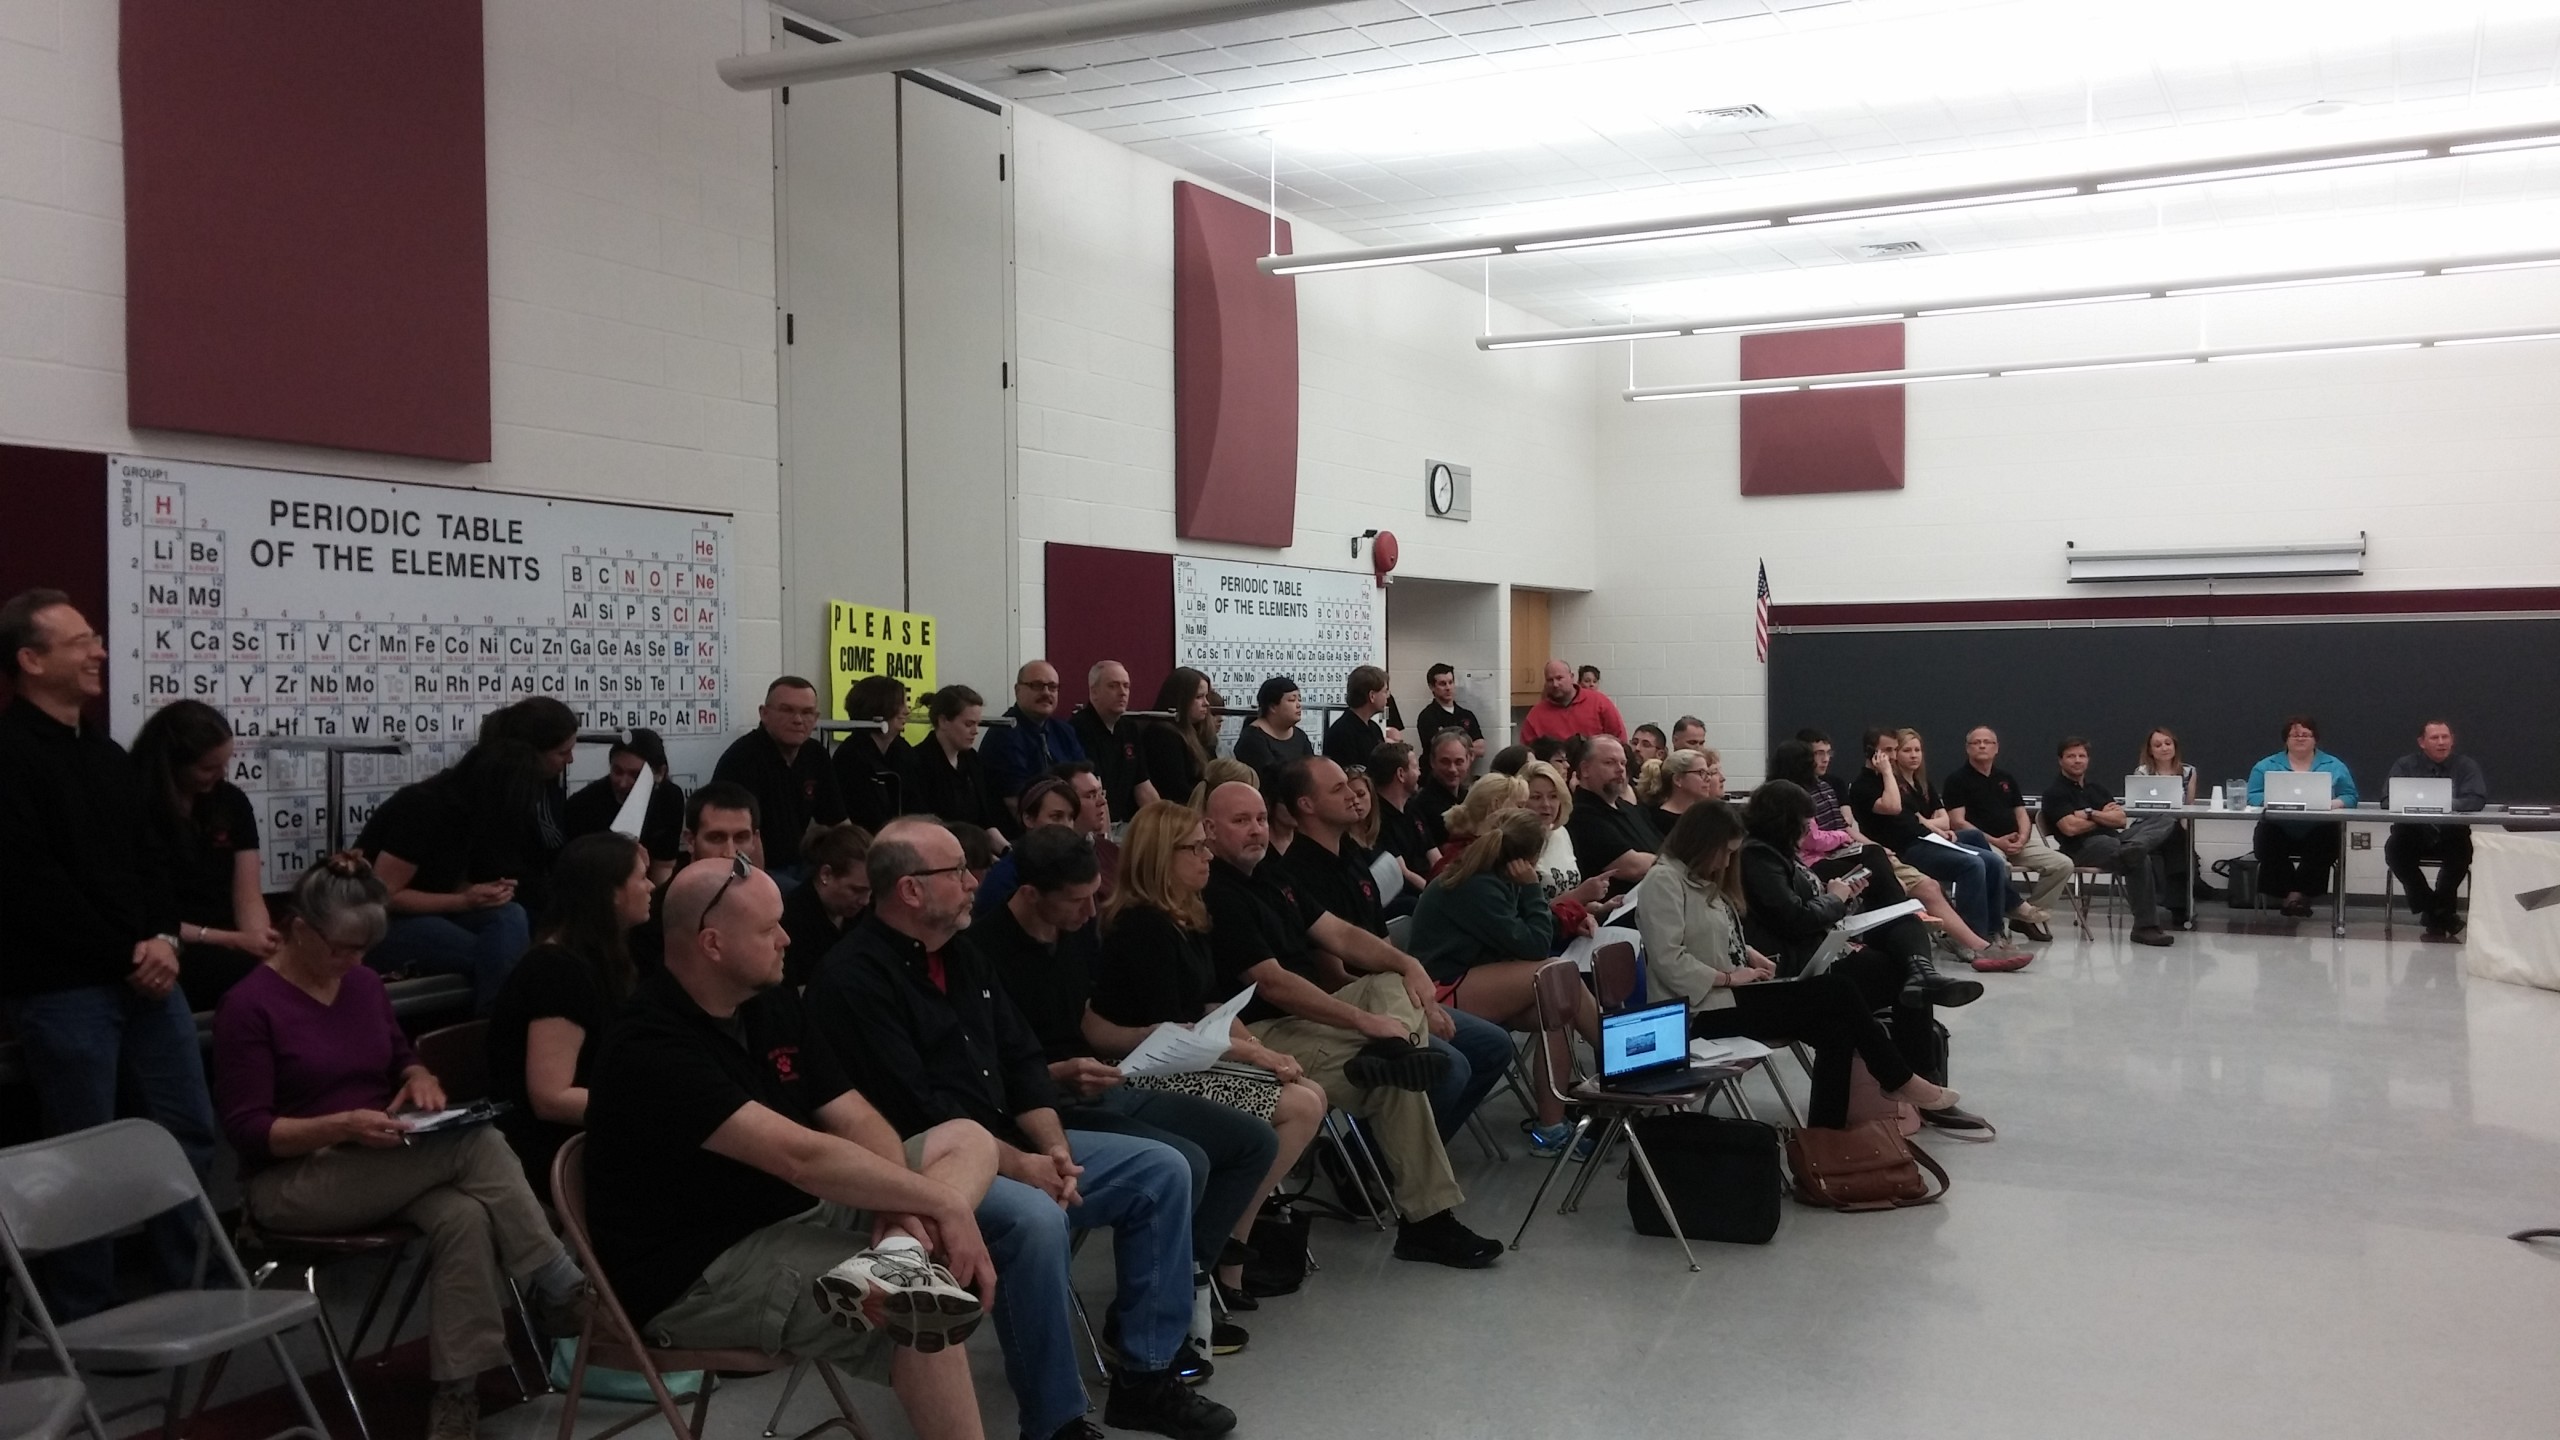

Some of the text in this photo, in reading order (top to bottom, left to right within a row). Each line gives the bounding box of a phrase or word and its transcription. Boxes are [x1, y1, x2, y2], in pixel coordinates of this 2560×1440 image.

[155, 495, 172, 515] H
[270, 499, 524, 545] PERIODIC TABLE
[154, 540, 174, 560] Li
[190, 541, 219, 563] Be
[695, 540, 714, 556] He
[131, 557, 139, 569] 2
[250, 538, 541, 582] OF THE ELEMENTS
[212, 576, 224, 588] 12
[571, 565, 583, 582] B
[598, 567, 610, 584] C
[624, 569, 635, 586] N
[649, 570, 661, 587] O
[676, 572, 685, 589] F
[695, 573, 715, 590] Ne
[1220, 575, 1303, 597] PERIODIC TABLE
[149, 584, 178, 606] Na
[188, 586, 221, 608] Mg
[131, 602, 140, 614] 3
[571, 602, 587, 619] Al
[598, 603, 614, 620] Si
[626, 604, 636, 621] P
[651, 605, 661, 622] S
[1196, 600, 1206, 611] Be
[1214, 597, 1309, 618] OF THE ELEMENTS
[1326, 608, 1332, 619] C
[673, 606, 689, 623] Cl
[697, 607, 714, 624] Ar
[1362, 610, 1370, 621] Ne
[210, 620, 224, 631] 20
[834, 604, 931, 646] PLEASE
[1185, 623, 1195, 635] Na
[1196, 624, 1207, 636] Mg
[156, 629, 171, 650] K
[190, 630, 220, 651] Ca
[232, 631, 260, 651] Sc
[276, 632, 296, 651] Ti
[316, 633, 330, 651] V
[347, 633, 371, 652] Cr
[380, 635, 407, 653] Mn
[415, 635, 436, 654] Fe
[1363, 631, 1370, 641] Ar
[444, 636, 470, 654] Co
[479, 636, 498, 654] Ni
[509, 637, 534, 655] Cu
[541, 637, 563, 655] Zn
[570, 638, 591, 656] Ga
[597, 639, 618, 656] Ge
[623, 639, 642, 656] As
[648, 640, 666, 657] Se
[674, 641, 690, 657] Br
[698, 641, 715, 657] Kr
[1187, 647, 1193, 659] K
[132, 648, 139, 660] 4
[839, 645, 924, 680] COME BACK
[1196, 648, 1207, 660] Ca
[1209, 648, 1219, 660] Sc
[1223, 648, 1230, 660] Ti
[1235, 649, 1241, 660] V
[1245, 649, 1254, 660] Cr
[1255, 649, 1265, 661] Mn
[1266, 649, 1274, 661] Fe
[1275, 650, 1284, 661] Co
[1286, 650, 1294, 661] Ni
[1296, 650, 1306, 661] Cu
[1308, 650, 1316, 661] Zn
[1317, 651, 1325, 661] Ga
[1326, 651, 1334, 661] Ge
[1335, 651, 1342, 661] As
[1343, 651, 1351, 662] Se
[1353, 651, 1360, 661] Br
[1363, 652, 1370, 661] Kr
[149, 674, 180, 695] Rb
[194, 674, 218, 695] Sr
[239, 675, 254, 694] Y
[275, 674, 298, 694] Zr
[310, 674, 338, 694] Nb
[345, 674, 375, 694] Mo
[414, 675, 438, 693] Ru
[446, 675, 469, 693] Rh
[478, 674, 501, 692] Pd
[511, 675, 535, 694] Ag
[541, 674, 564, 692] Cd
[574, 675, 589, 692] In
[599, 675, 618, 692] Sn
[624, 675, 642, 692] Sb
[650, 675, 665, 692] Te
[679, 676, 685, 691] I
[698, 675, 716, 690] Xe
[1211, 671, 1217, 682] Y
[1222, 672, 1231, 683] Zr
[1233, 672, 1244, 683] Nb
[1244, 672, 1255, 683] Mo
[1297, 672, 1307, 683] Ag
[1308, 672, 1317, 682] Cd
[1326, 672, 1334, 683] Sn
[1335, 672, 1343, 683] Sb
[132, 693, 140, 705] 5
[1234, 695, 1242, 706] Ta
[1246, 695, 1253, 706] W
[352, 716, 370, 734] W
[382, 715, 406, 734] Re
[415, 714, 439, 733] Os
[452, 714, 465, 731] Ir
[599, 711, 618, 728] Pb
[627, 711, 641, 727] Bi
[649, 710, 667, 726] Po
[675, 710, 691, 726] At
[698, 709, 717, 724] Rn
[235, 718, 260, 737] La
[275, 717, 299, 736] Hf
[314, 716, 336, 735] Ta
[234, 761, 262, 780] Ac
[274, 809, 303, 829] Ce
[277, 851, 304, 871] Th
